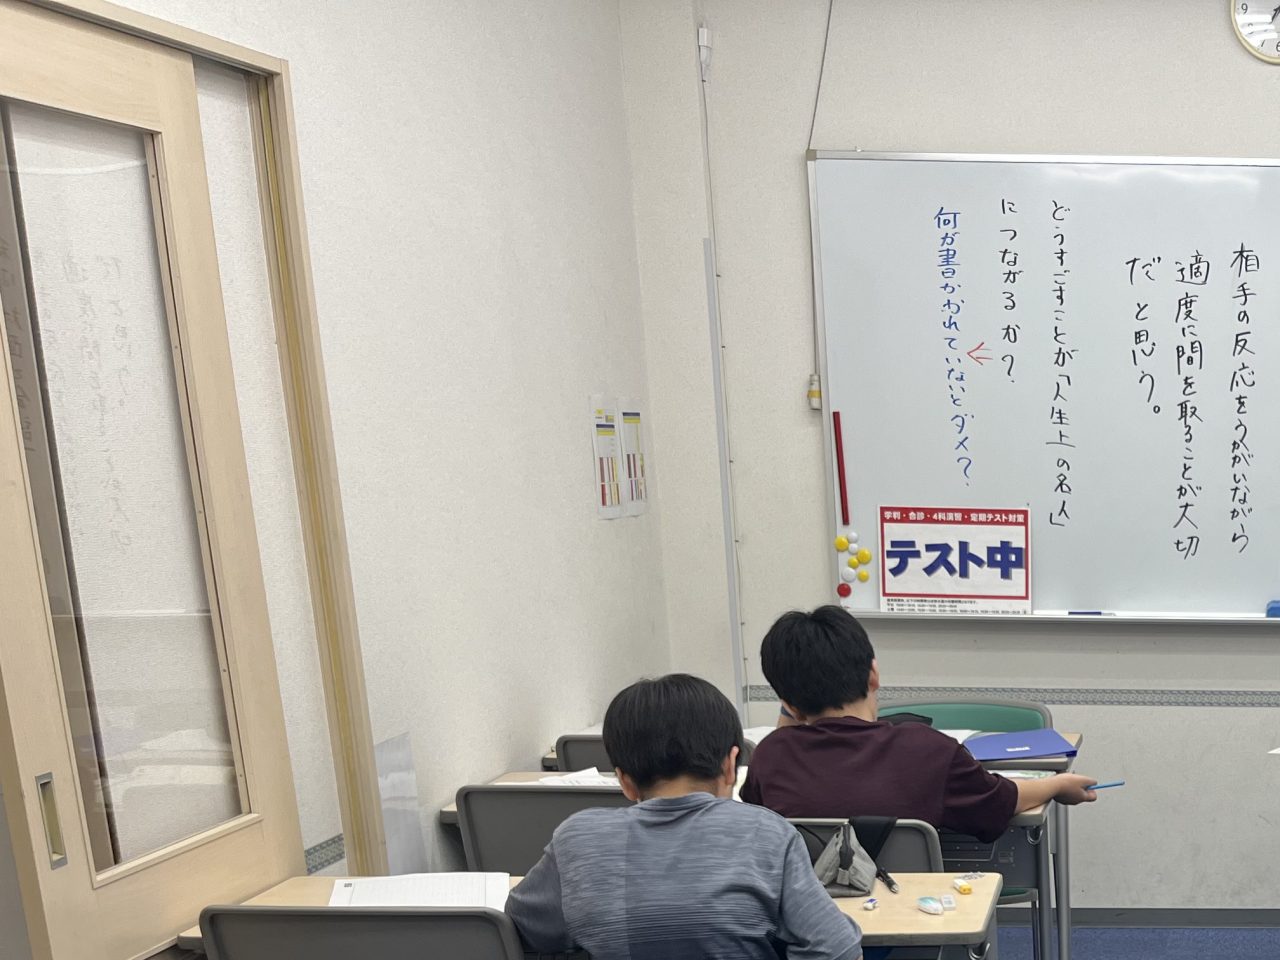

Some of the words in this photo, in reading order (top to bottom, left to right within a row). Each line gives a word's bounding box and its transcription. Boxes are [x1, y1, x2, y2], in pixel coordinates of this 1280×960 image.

[1241, 3, 1249, 14] 9
[885, 540, 1026, 580] テスト中
